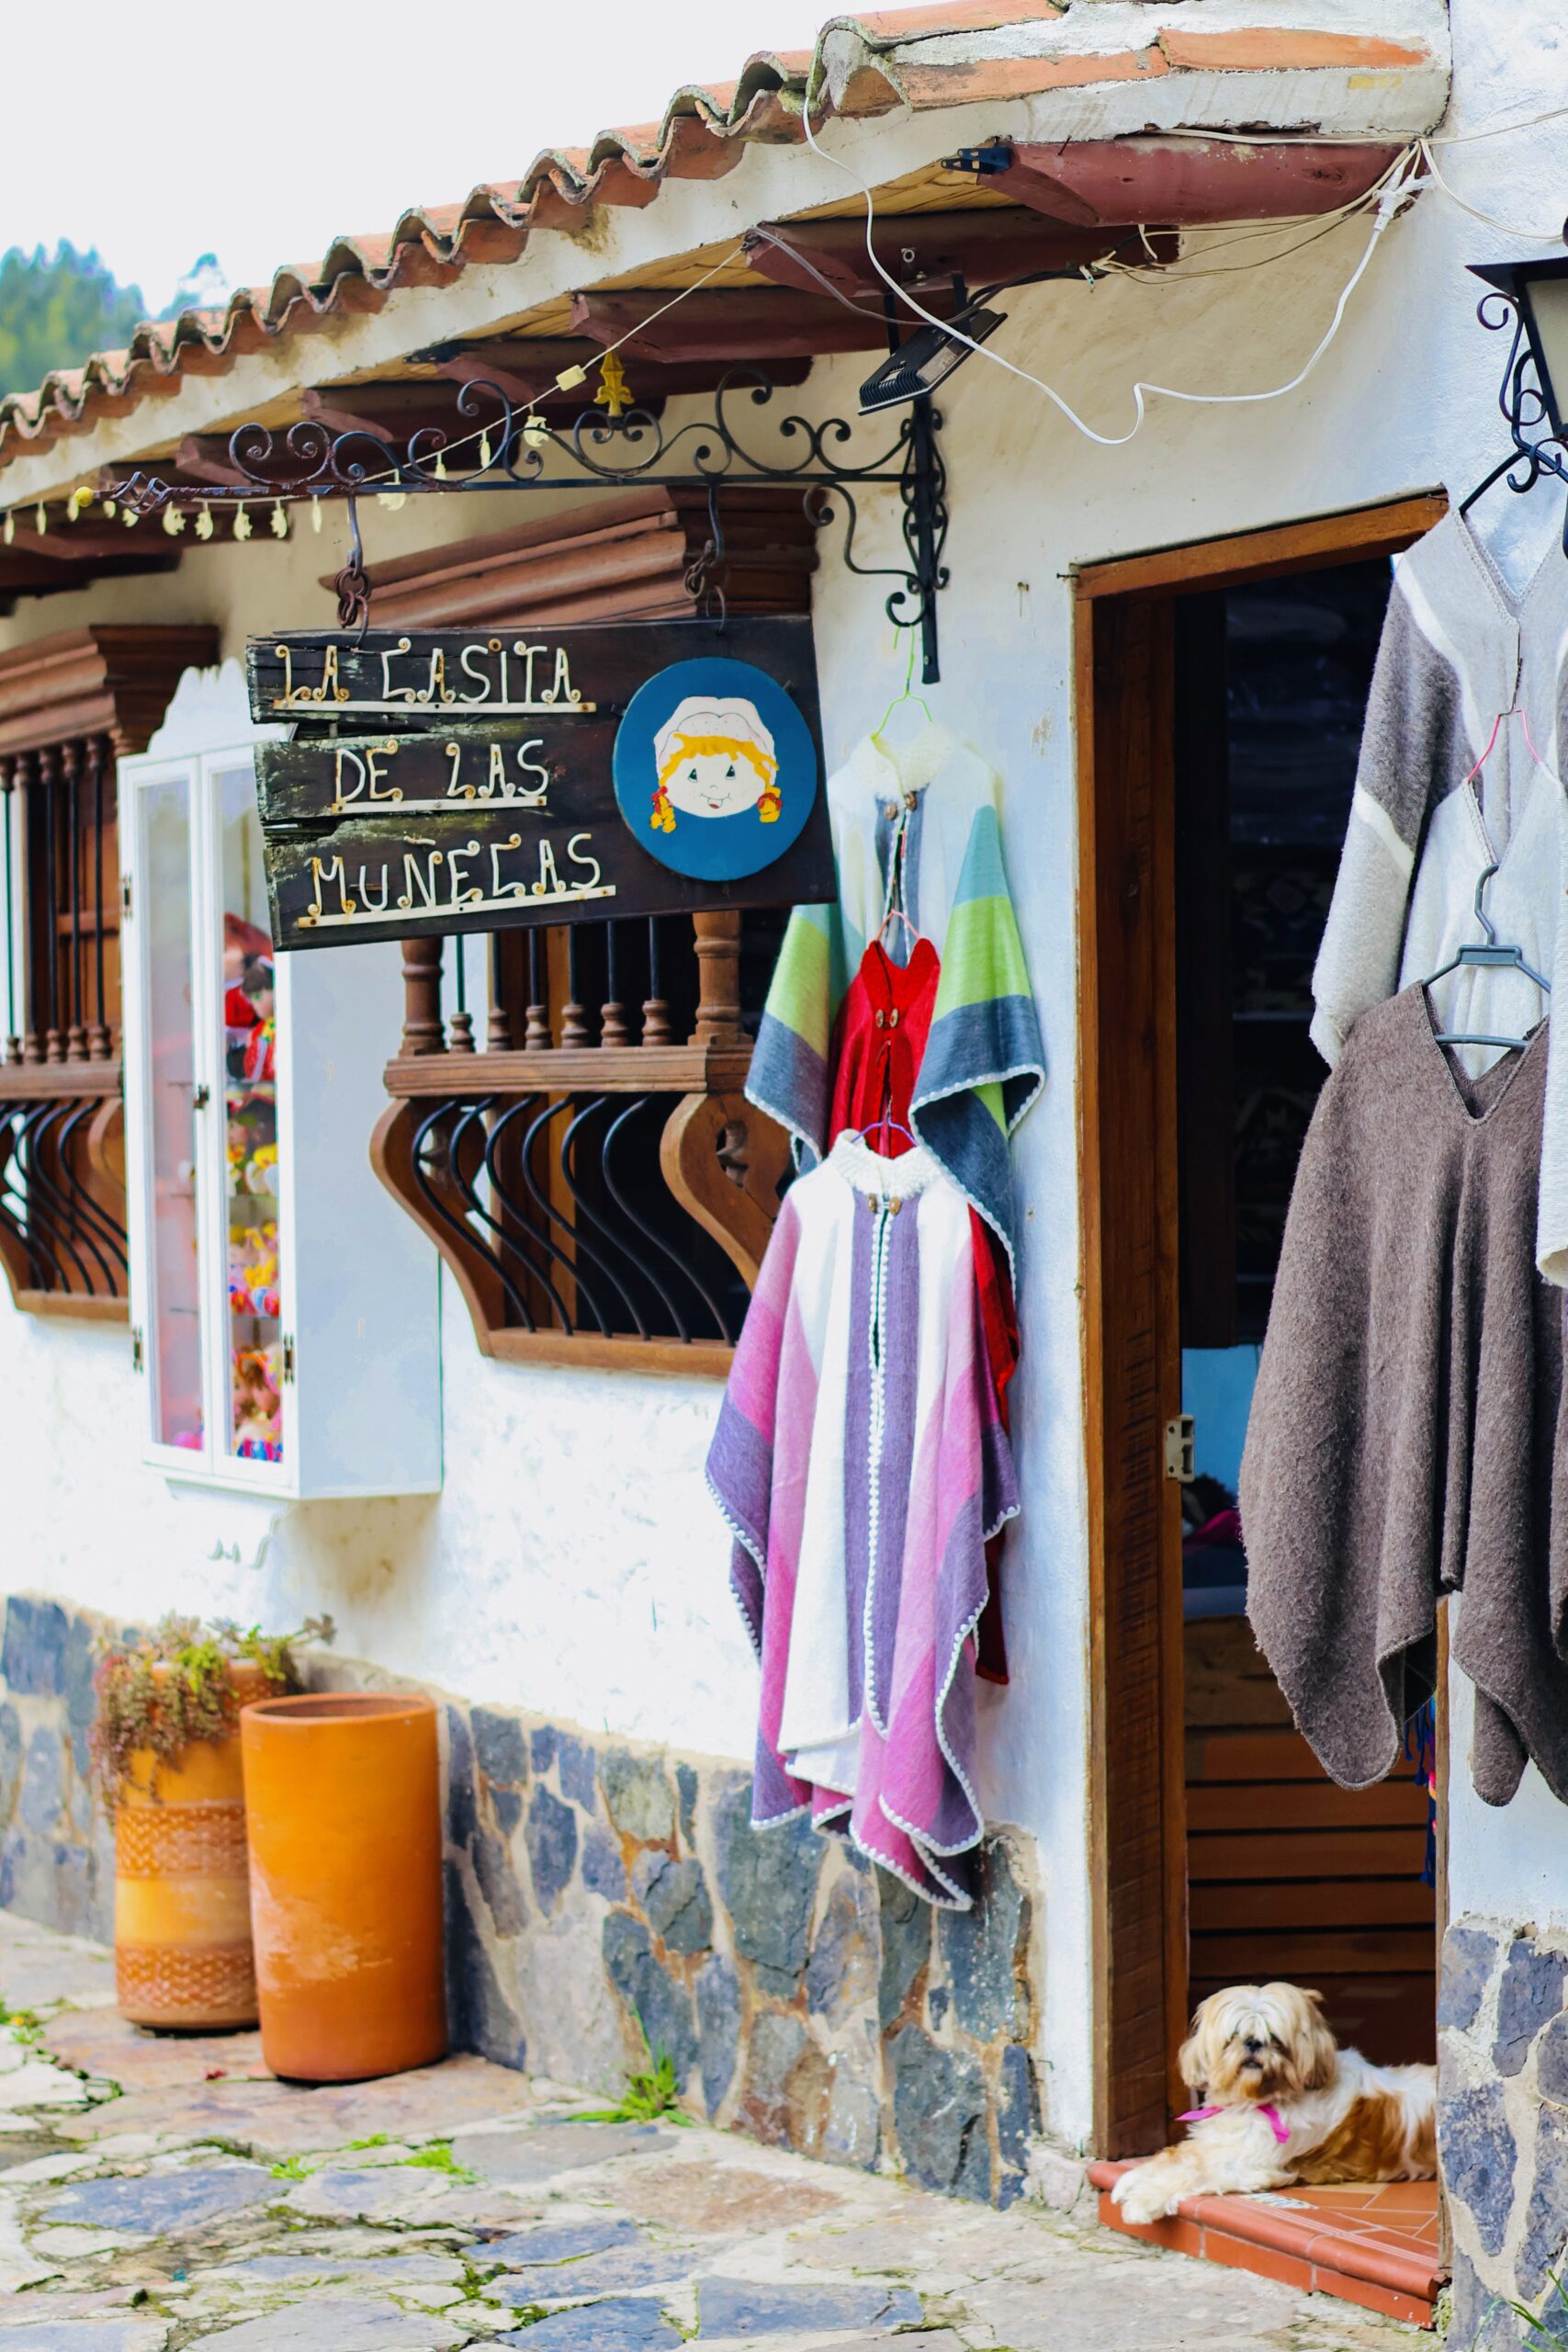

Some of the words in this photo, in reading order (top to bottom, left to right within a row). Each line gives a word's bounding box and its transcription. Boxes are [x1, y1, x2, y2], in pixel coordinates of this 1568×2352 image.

[276, 644, 350, 702] LA
[380, 638, 582, 705] CASITA
[335, 740, 403, 802] DE
[446, 740, 549, 797] LAS
[307, 833, 602, 916] MUÑECAS
